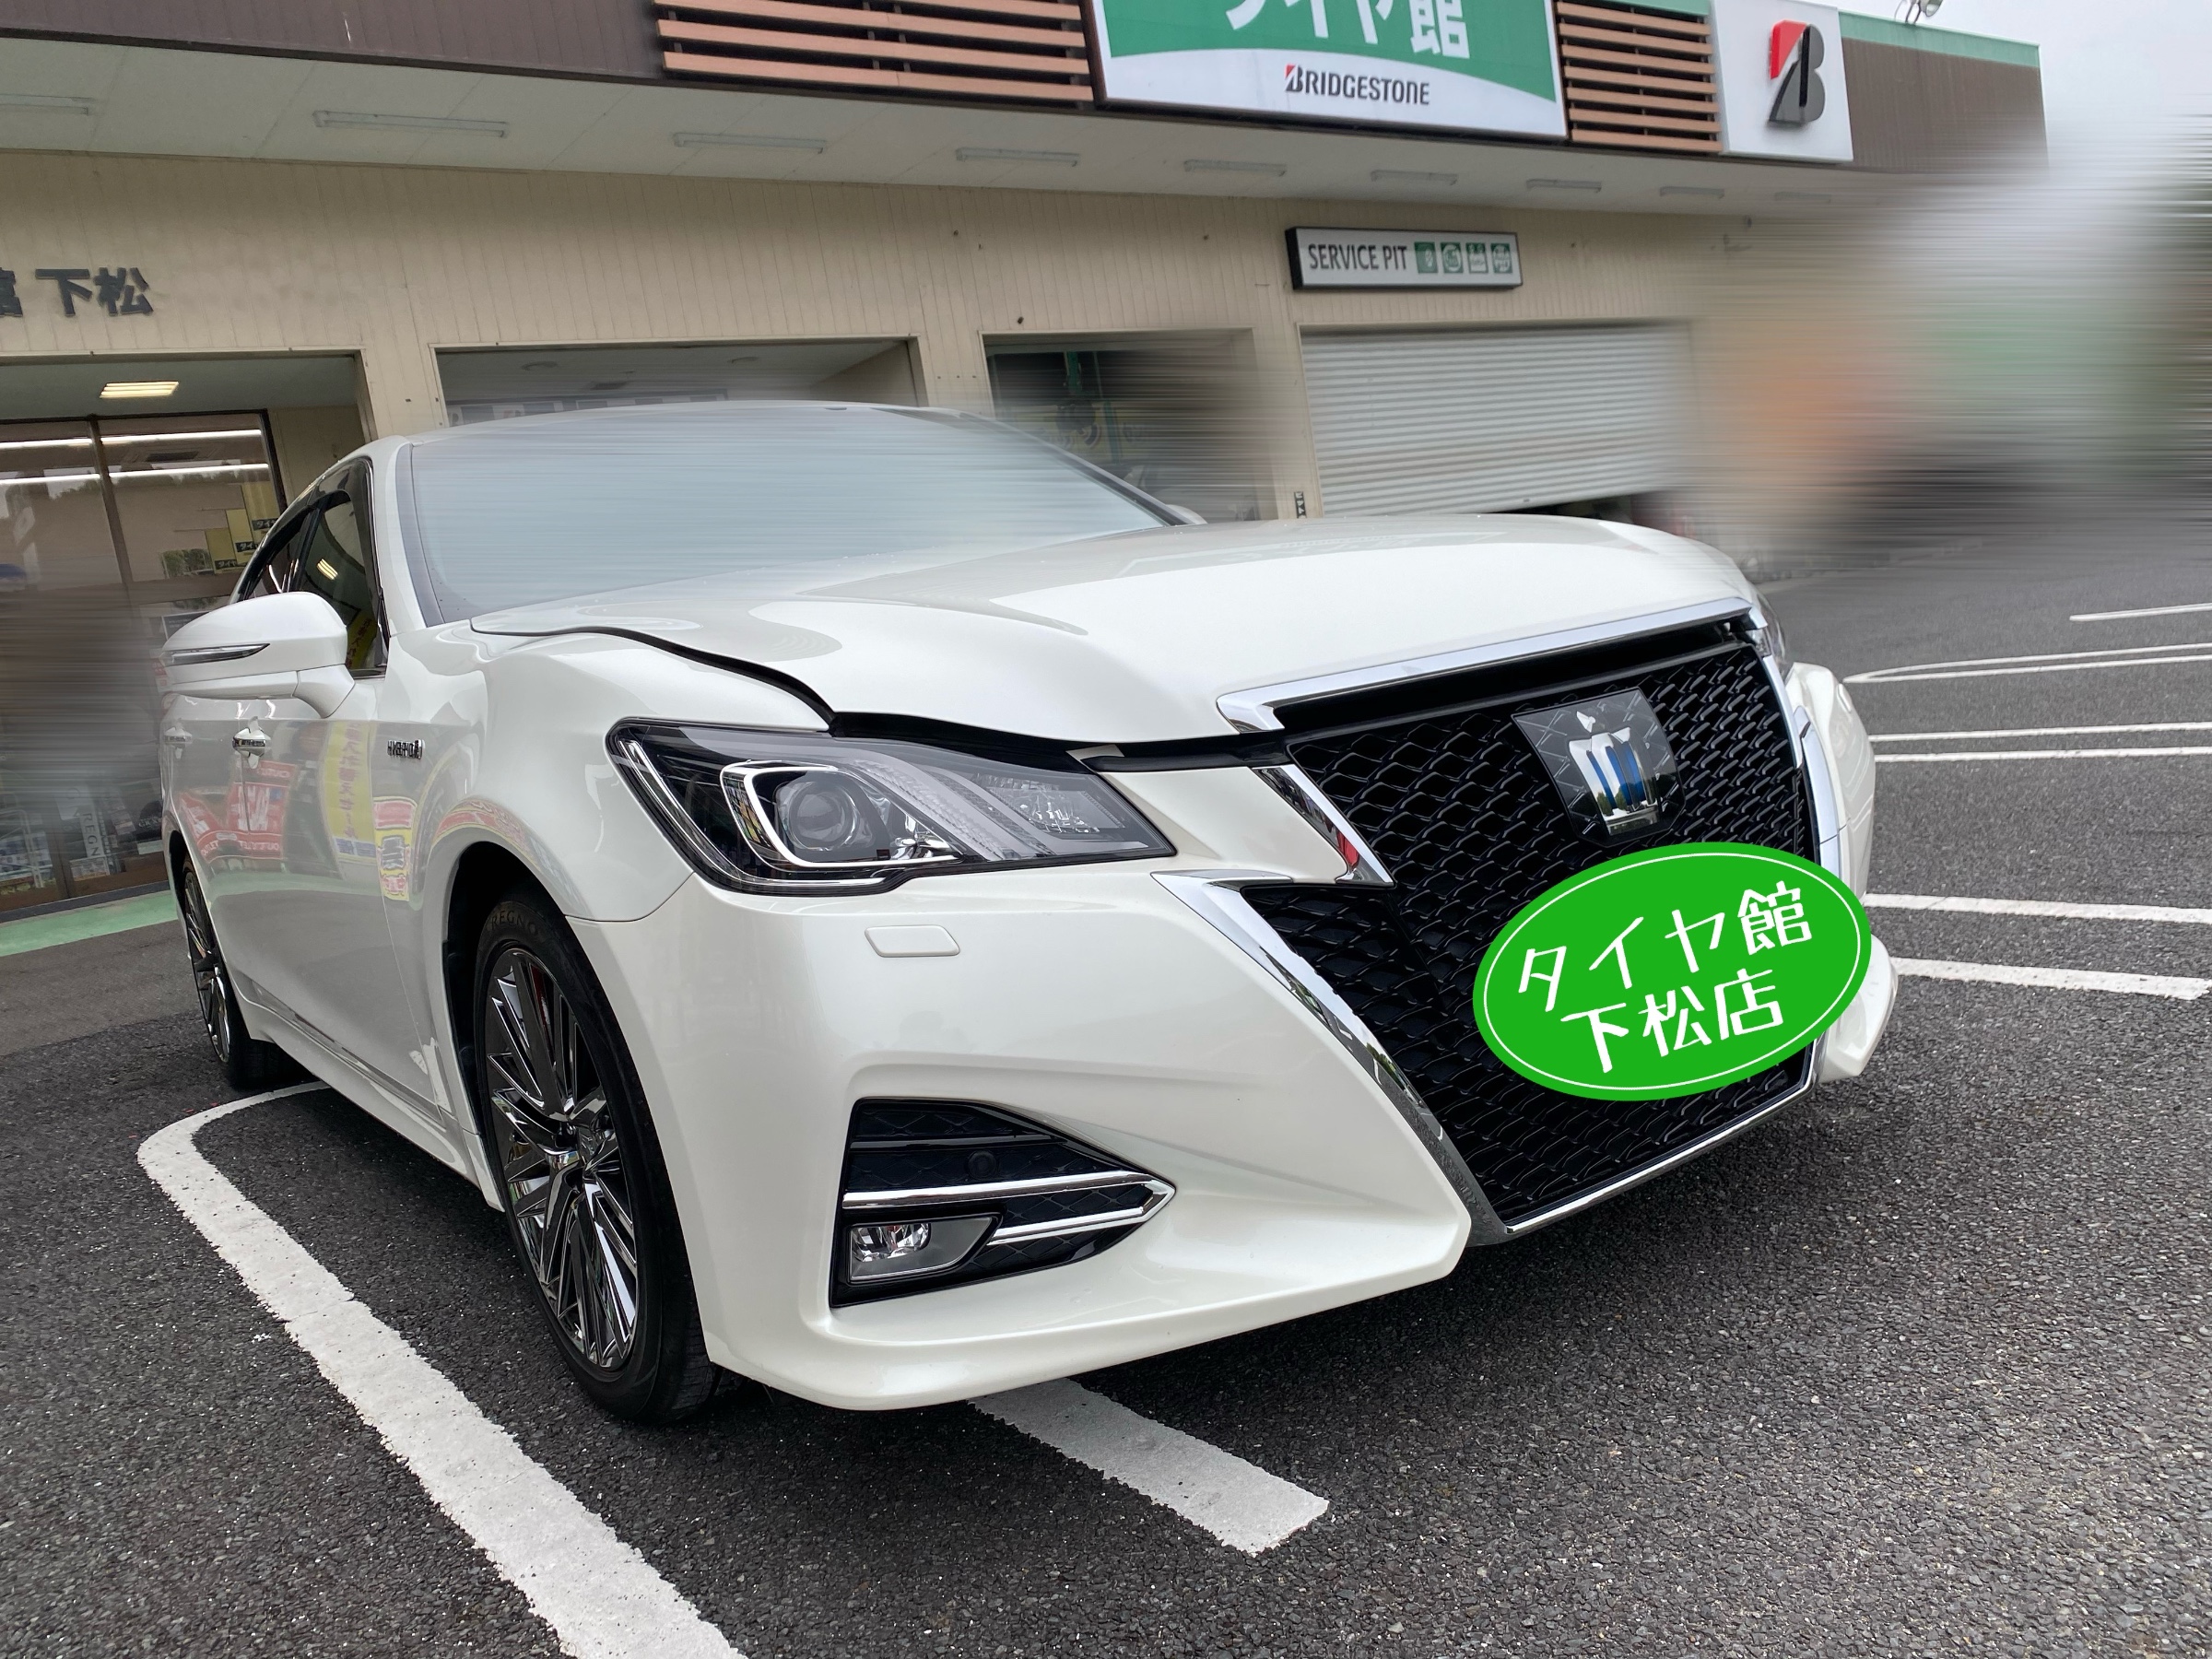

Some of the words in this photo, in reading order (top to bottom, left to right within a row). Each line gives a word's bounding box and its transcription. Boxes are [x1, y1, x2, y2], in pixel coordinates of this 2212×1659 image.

[1285, 64, 1430, 106] BRIDGESTONE
[1308, 243, 1380, 270] SERVICE
[1383, 245, 1408, 270] PIT
